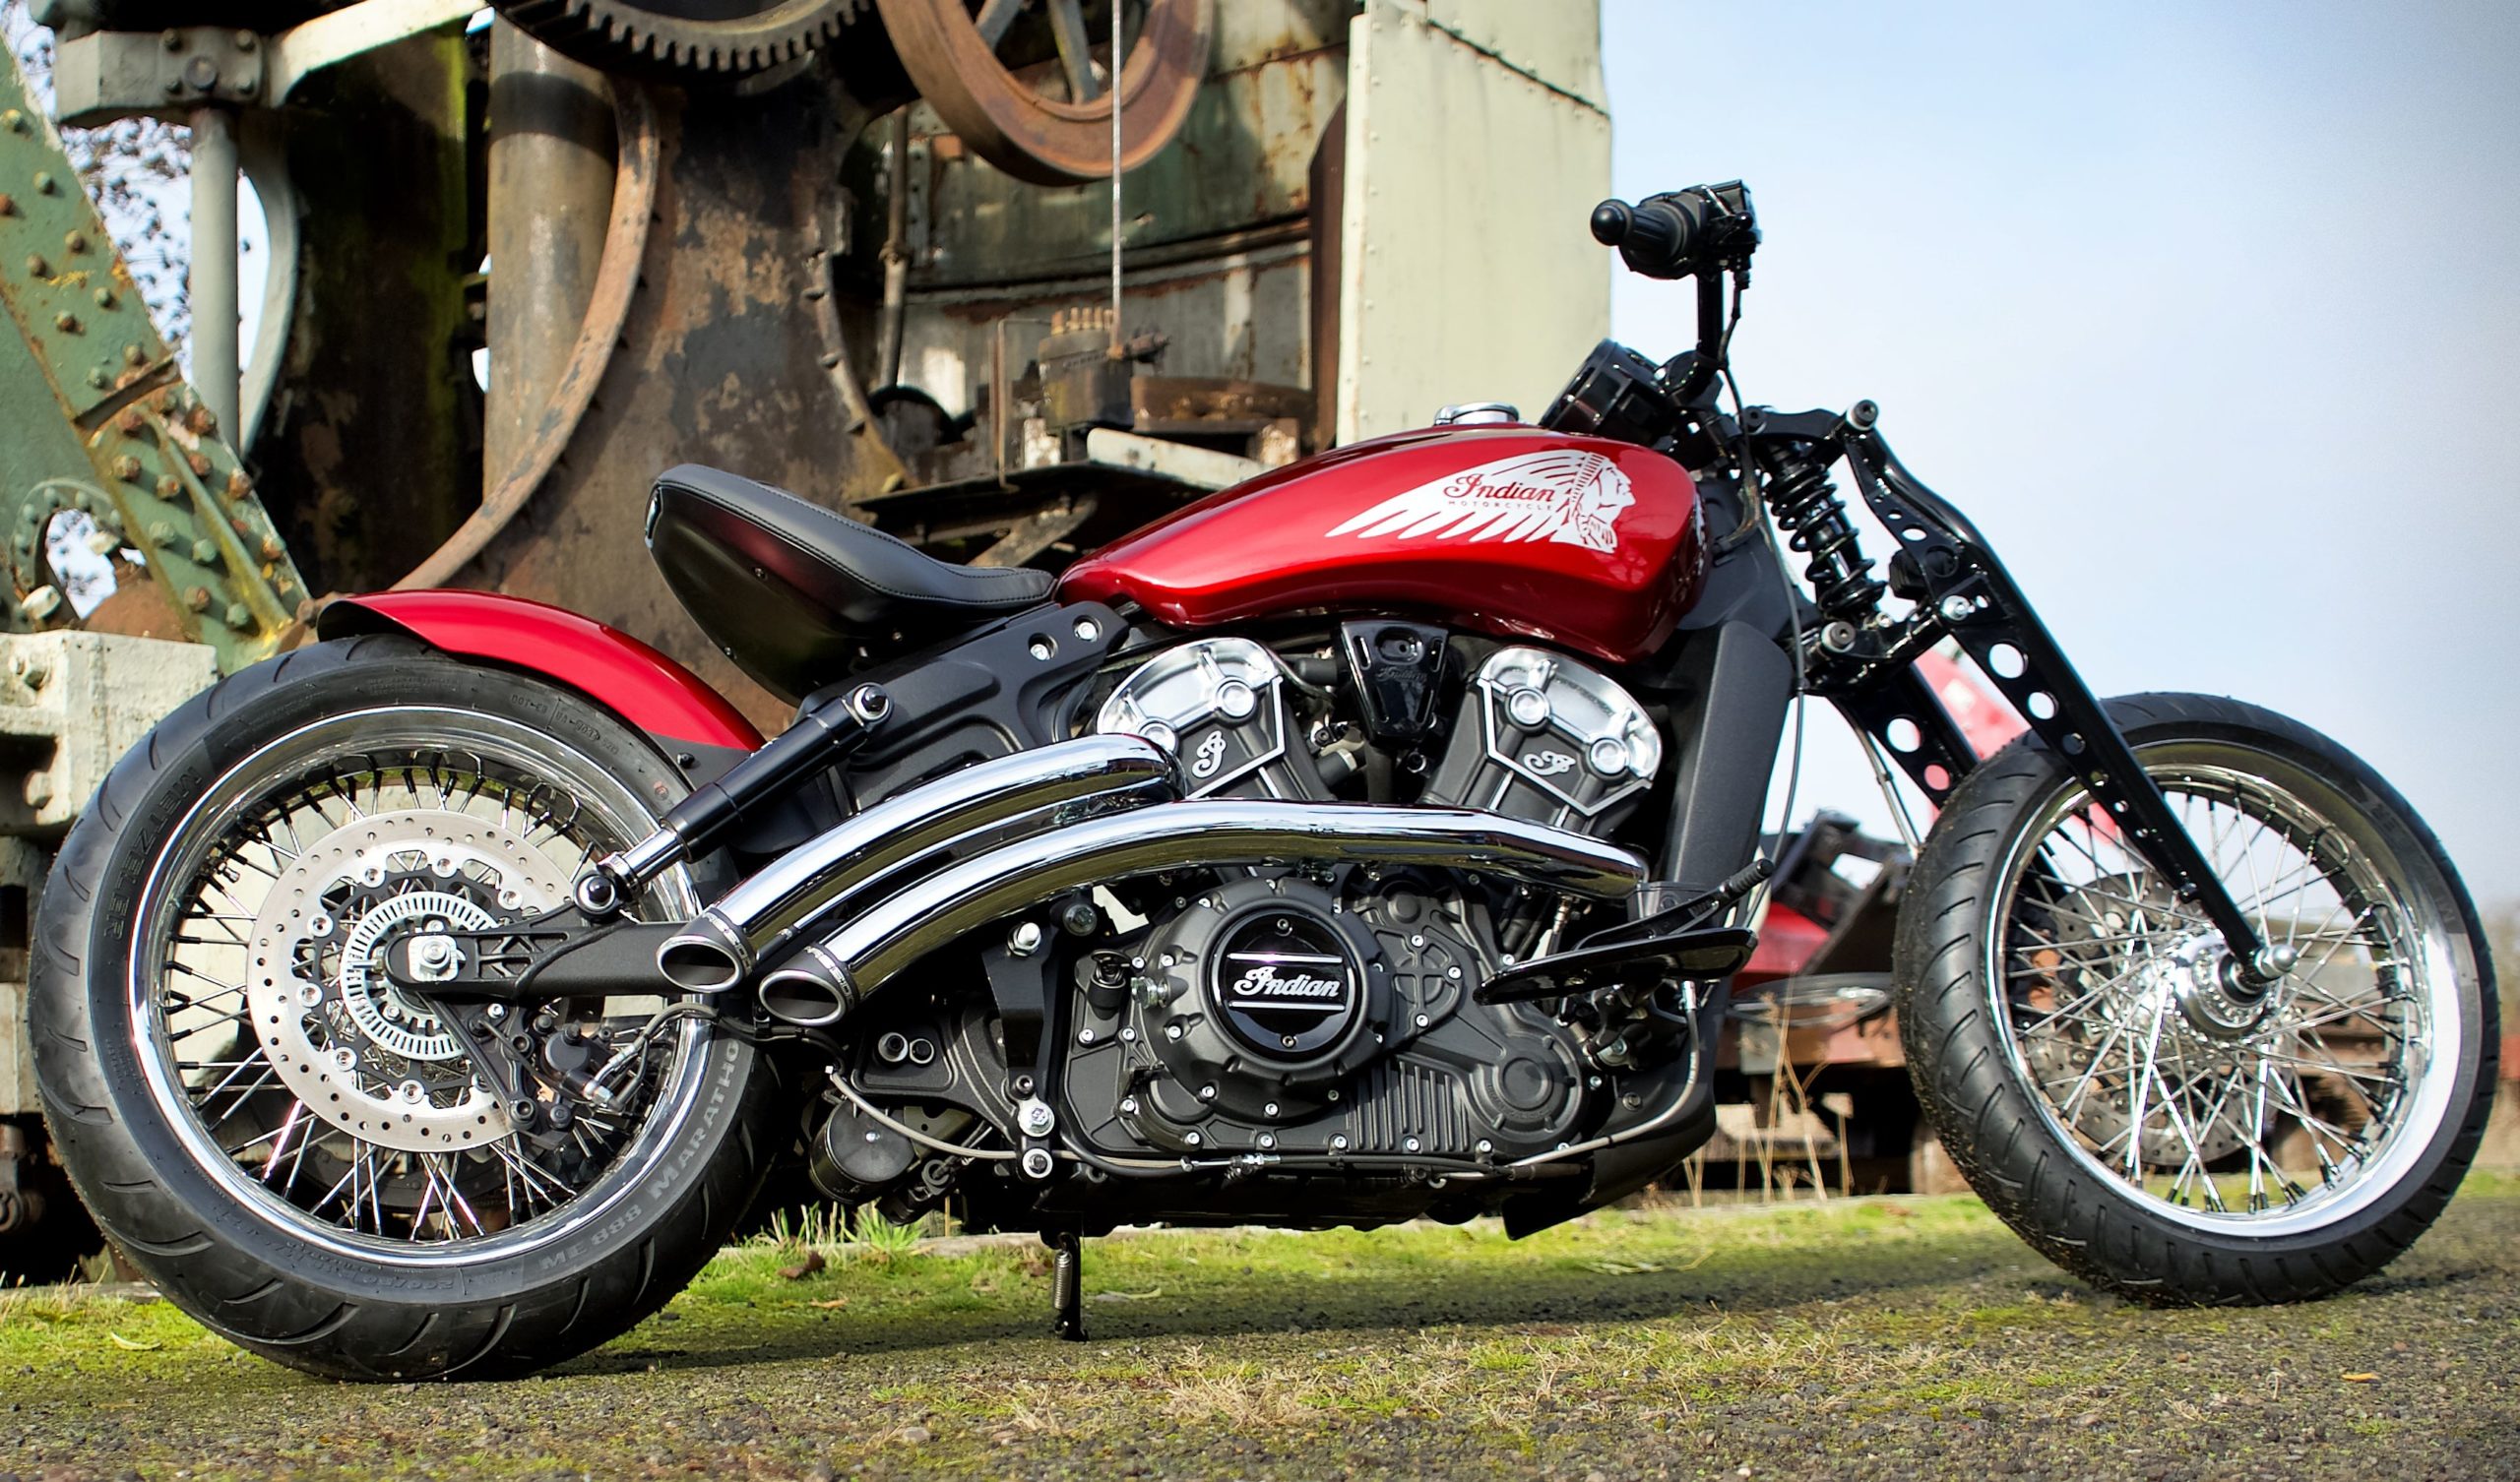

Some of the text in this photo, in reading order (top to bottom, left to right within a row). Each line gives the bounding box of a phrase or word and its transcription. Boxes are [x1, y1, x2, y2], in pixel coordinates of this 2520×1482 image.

[1443, 473, 1555, 502] Indian
[1448, 500, 1552, 511] MOTORCYCLE
[103, 766, 203, 940] METZELER
[1233, 965, 1341, 997] Indian
[540, 1239, 588, 1269] ME
[592, 1203, 644, 1246] 888
